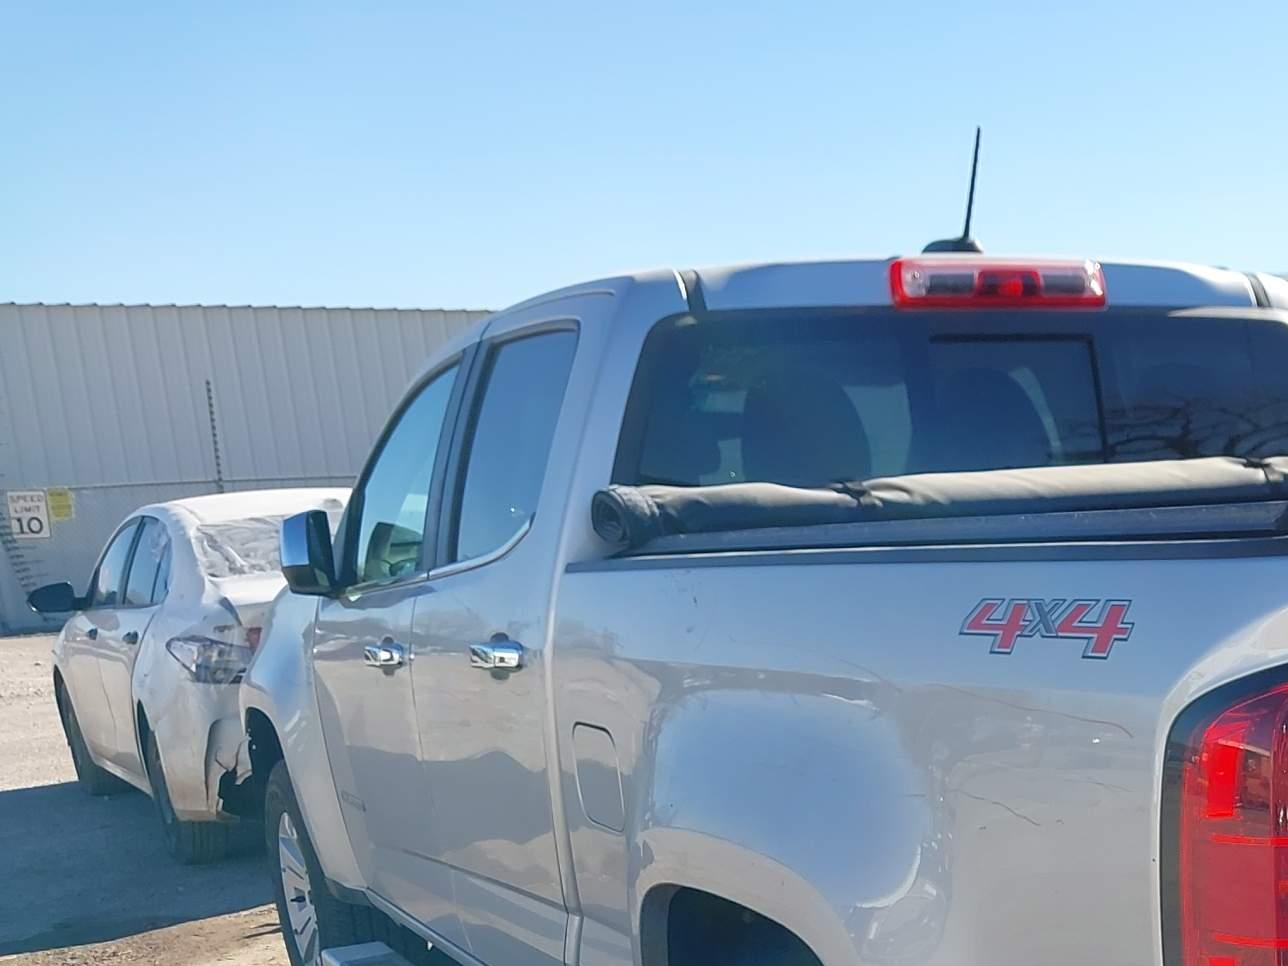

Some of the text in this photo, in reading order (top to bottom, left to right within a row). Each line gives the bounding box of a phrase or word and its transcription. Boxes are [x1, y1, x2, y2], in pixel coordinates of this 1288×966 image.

[10, 495, 44, 503] SPEED
[14, 505, 41, 513] LIMIT
[12, 516, 43, 534] 10
